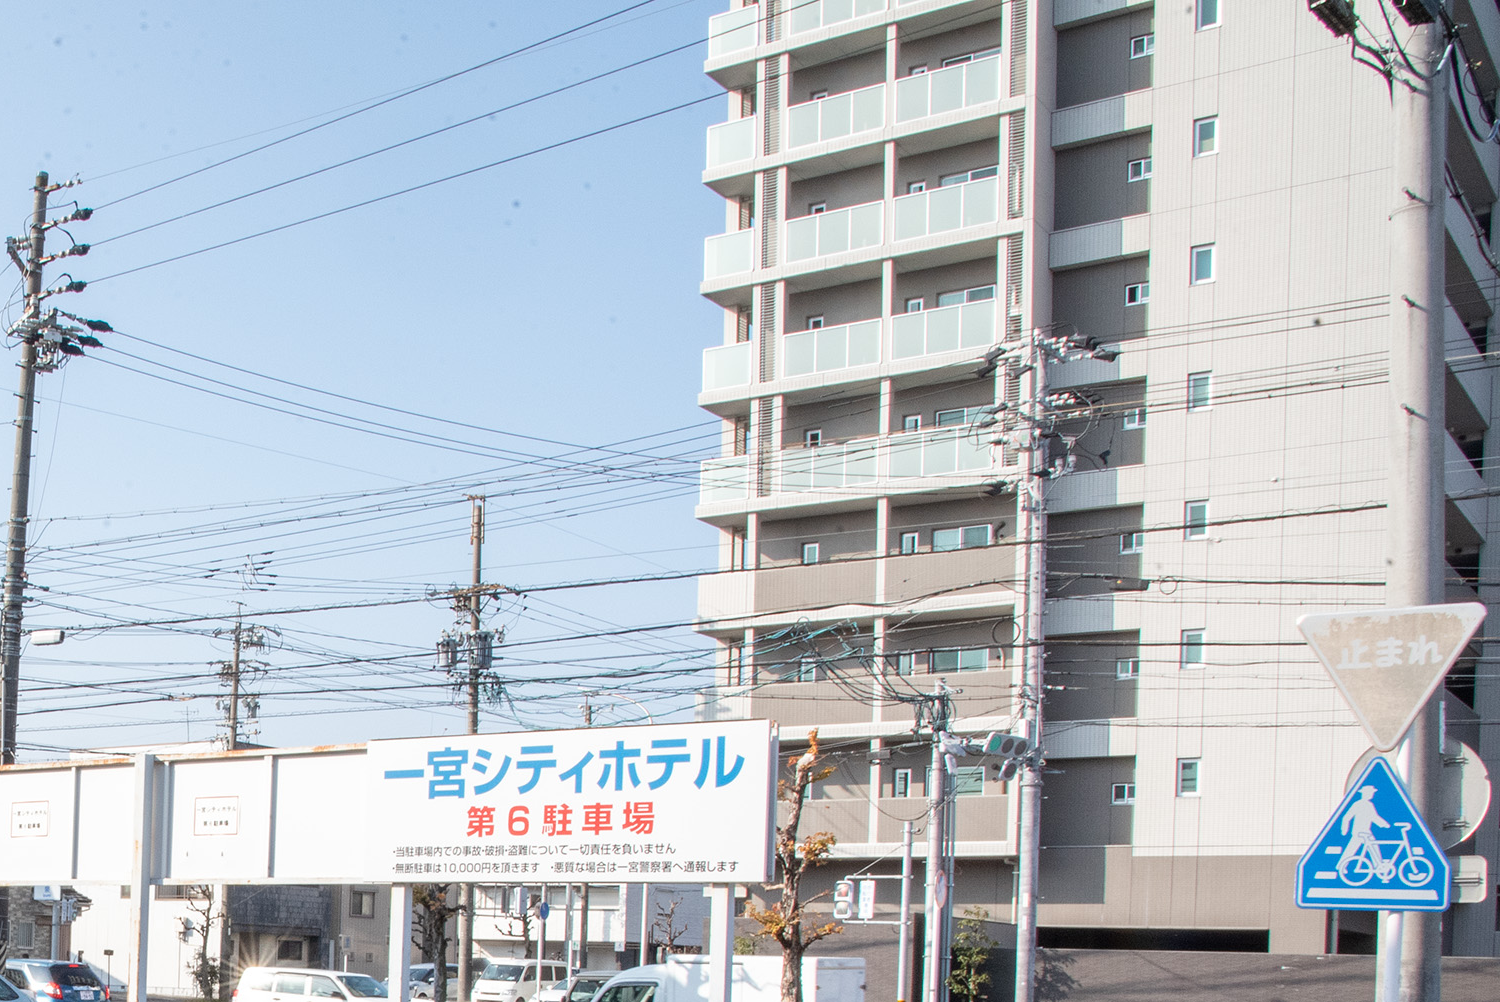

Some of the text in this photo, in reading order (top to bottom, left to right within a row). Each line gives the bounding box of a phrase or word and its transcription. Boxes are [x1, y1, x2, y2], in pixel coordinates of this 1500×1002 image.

[1336, 637, 1442, 669] 止まれ
[383, 735, 746, 800] 一宮シティホテル
[466, 801, 655, 838] 第6駐車場
